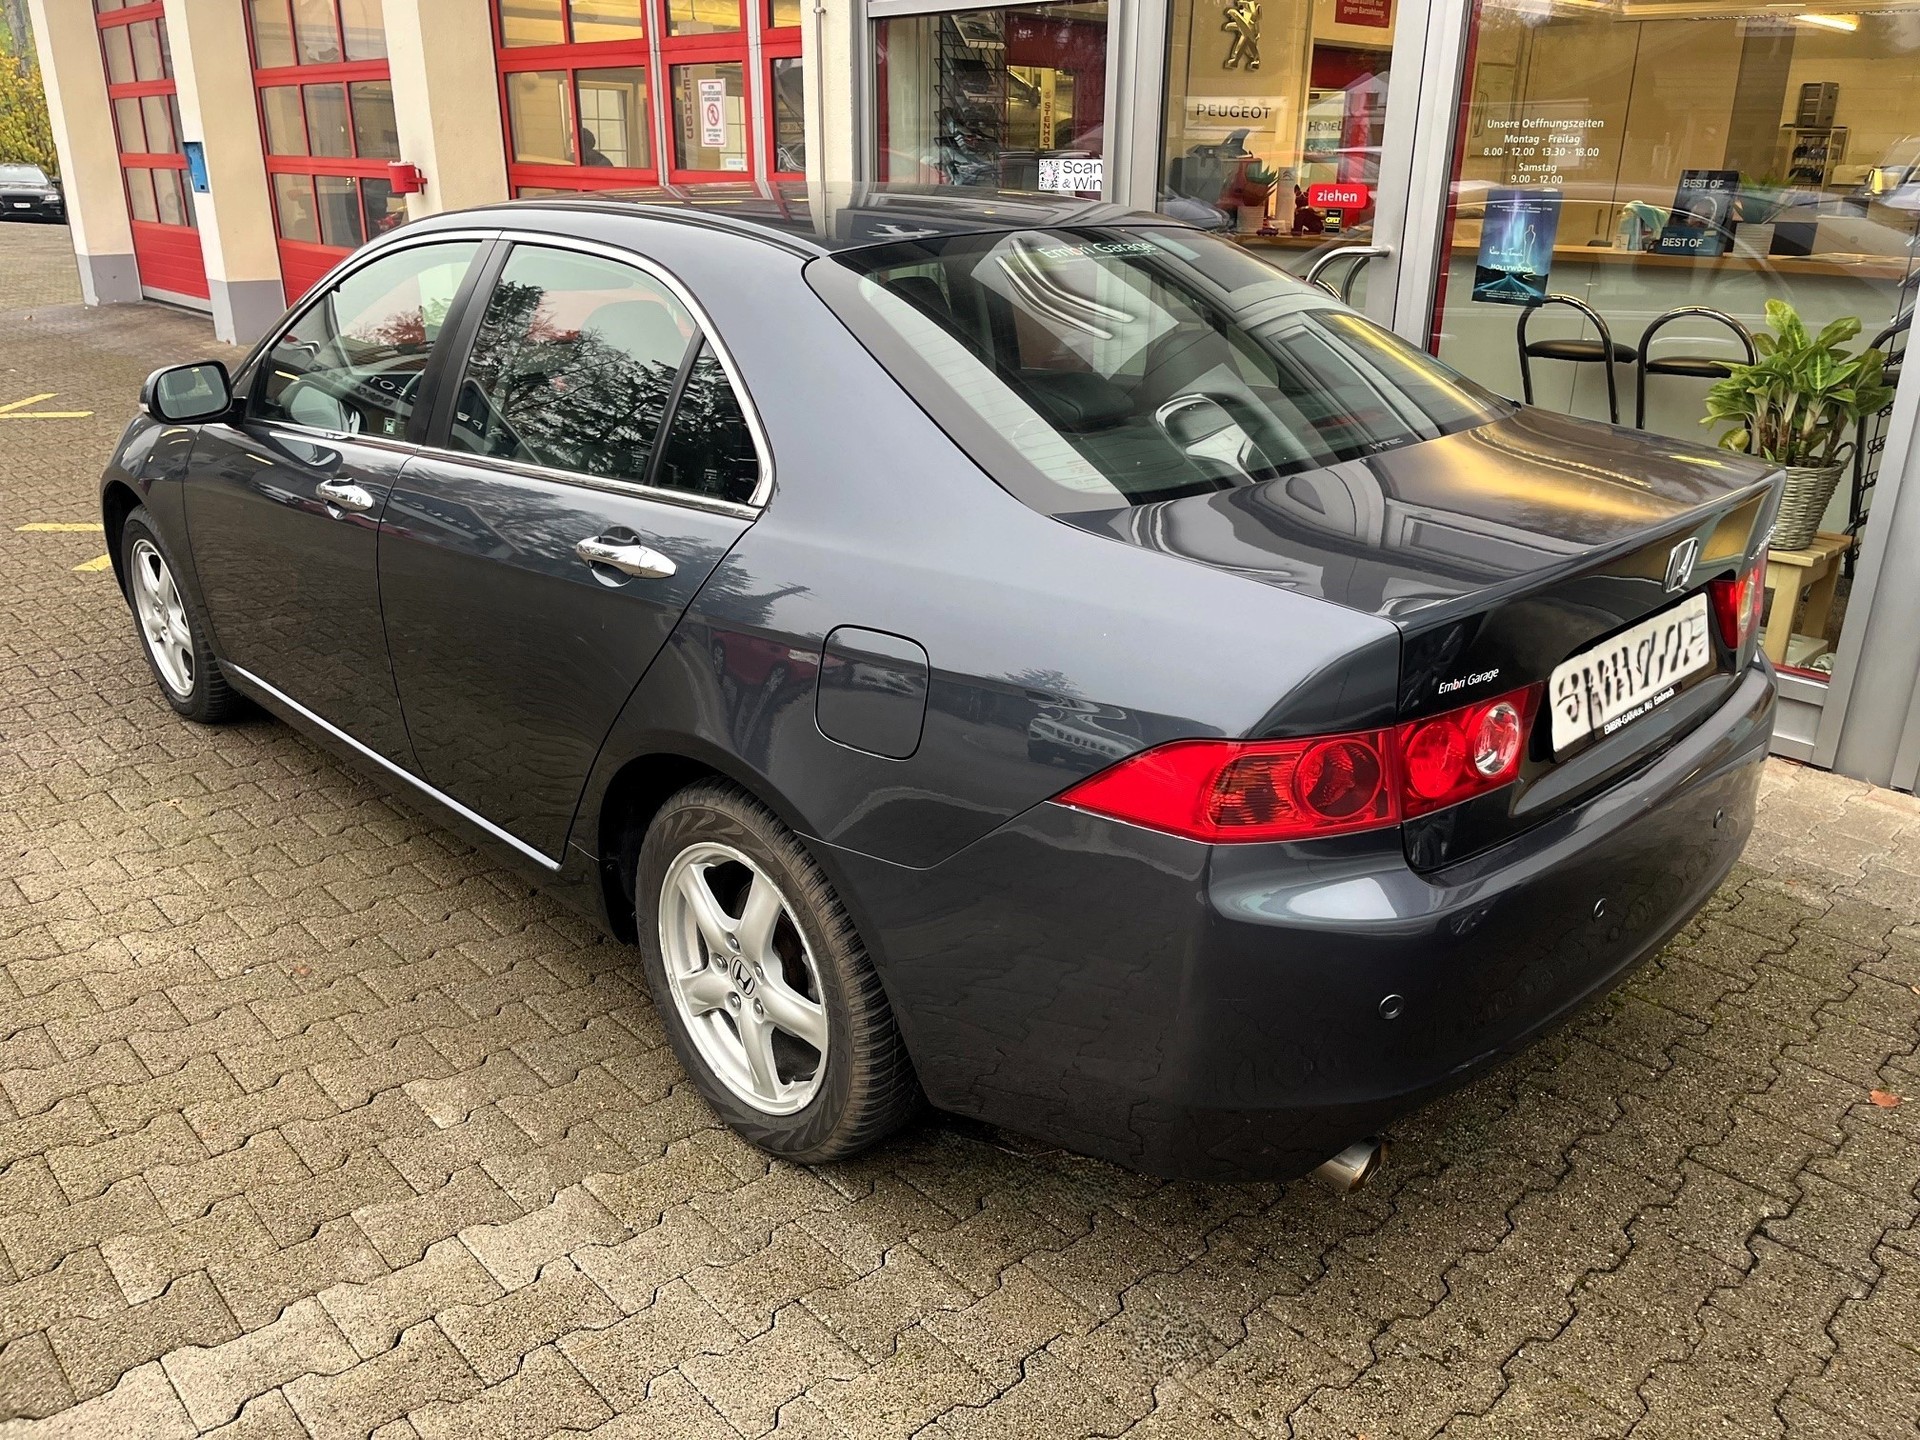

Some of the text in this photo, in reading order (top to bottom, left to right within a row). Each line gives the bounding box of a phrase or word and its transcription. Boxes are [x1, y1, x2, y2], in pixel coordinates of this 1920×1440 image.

[683, 67, 693, 139] TENHØJ
[1196, 103, 1271, 119] PEUGEOT
[1487, 118, 1604, 130] Unsere Oeffnungszeiten
[1504, 135, 1540, 144] Montag
[1548, 134, 1581, 145] Freitag
[1483, 147, 1503, 156] 8.00
[1511, 147, 1535, 156] 12.00
[1542, 147, 1566, 156] 13.30
[1575, 148, 1599, 157] 18.00
[1062, 160, 1102, 174] Scan
[1518, 162, 1557, 174] Samstag
[1073, 175, 1102, 190] Win
[1511, 174, 1530, 184] 9.00
[1539, 175, 1563, 184] 12.00
[1682, 179, 1725, 189] BEST OF
[1317, 190, 1357, 203] ziehen
[1092, 242, 1156, 254] Garage
[1661, 238, 1704, 248] BEST OF
[1438, 668, 1499, 694] Embri Garage
